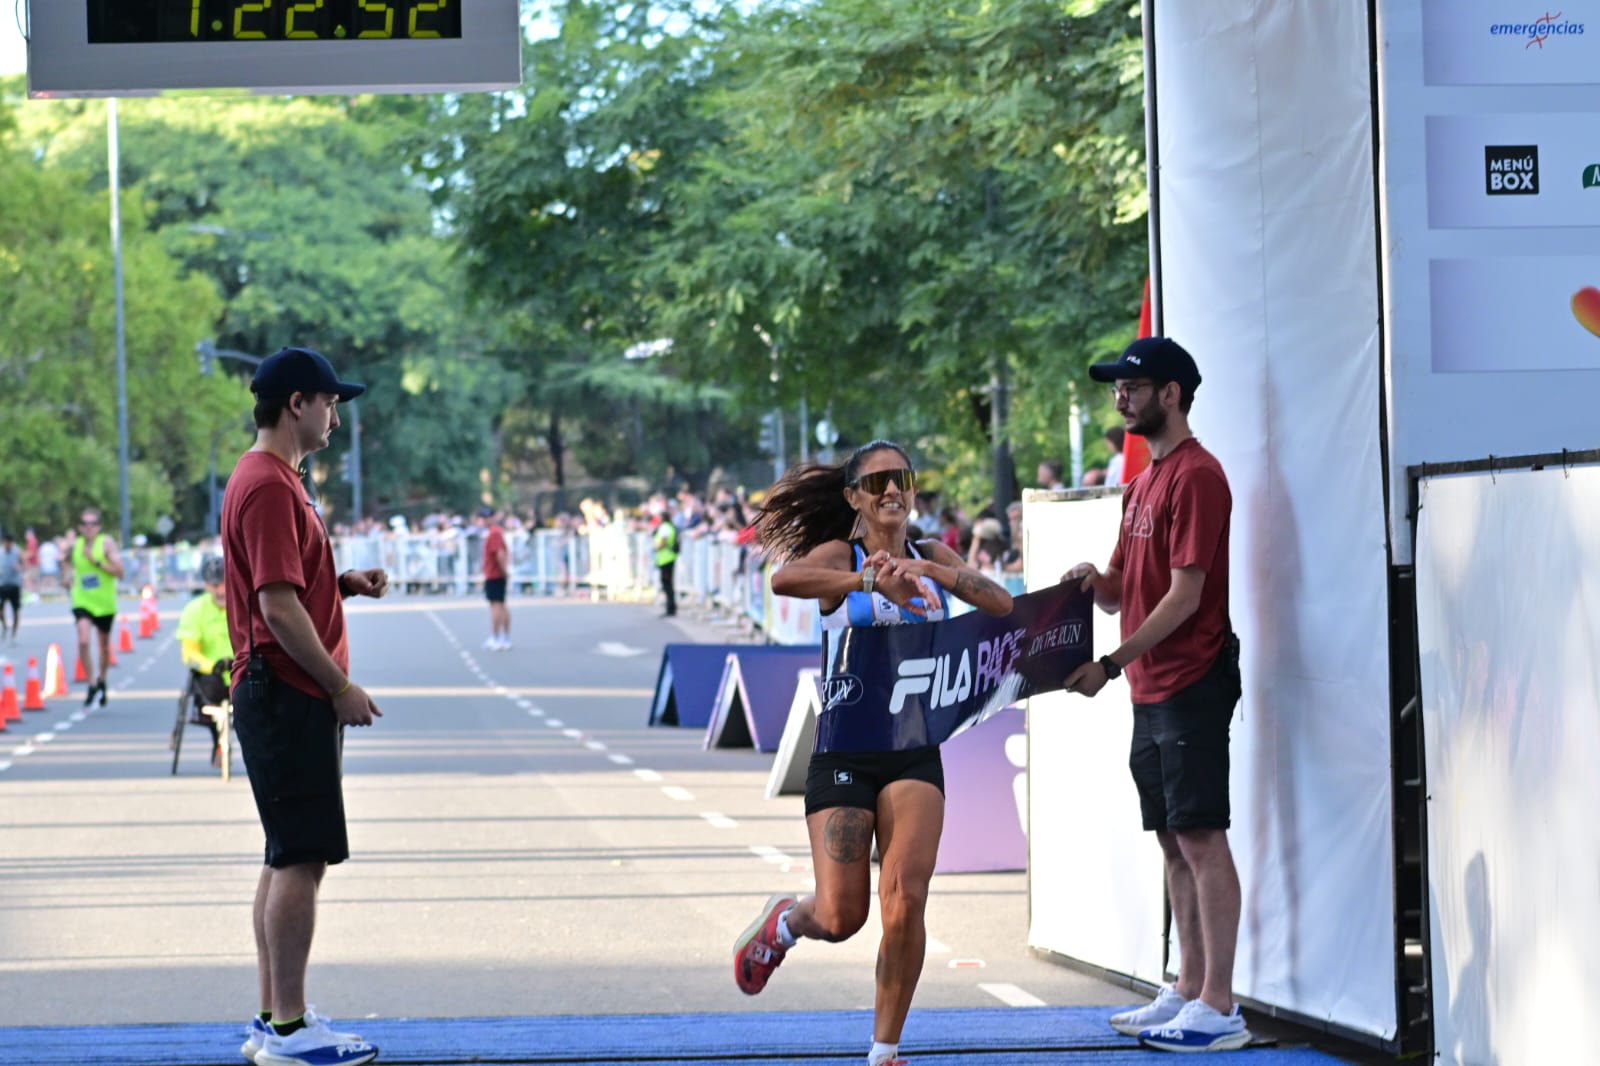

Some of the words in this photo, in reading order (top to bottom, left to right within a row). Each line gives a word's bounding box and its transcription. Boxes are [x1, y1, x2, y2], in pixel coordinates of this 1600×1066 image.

[1490, 20, 1585, 39] emergencias
[1490, 155, 1534, 171] MENÚ
[1490, 173, 1535, 191] BOX
[889, 647, 972, 714] FILA
[974, 628, 1027, 696] RACE
[1150, 1029, 1184, 1041] FILA
